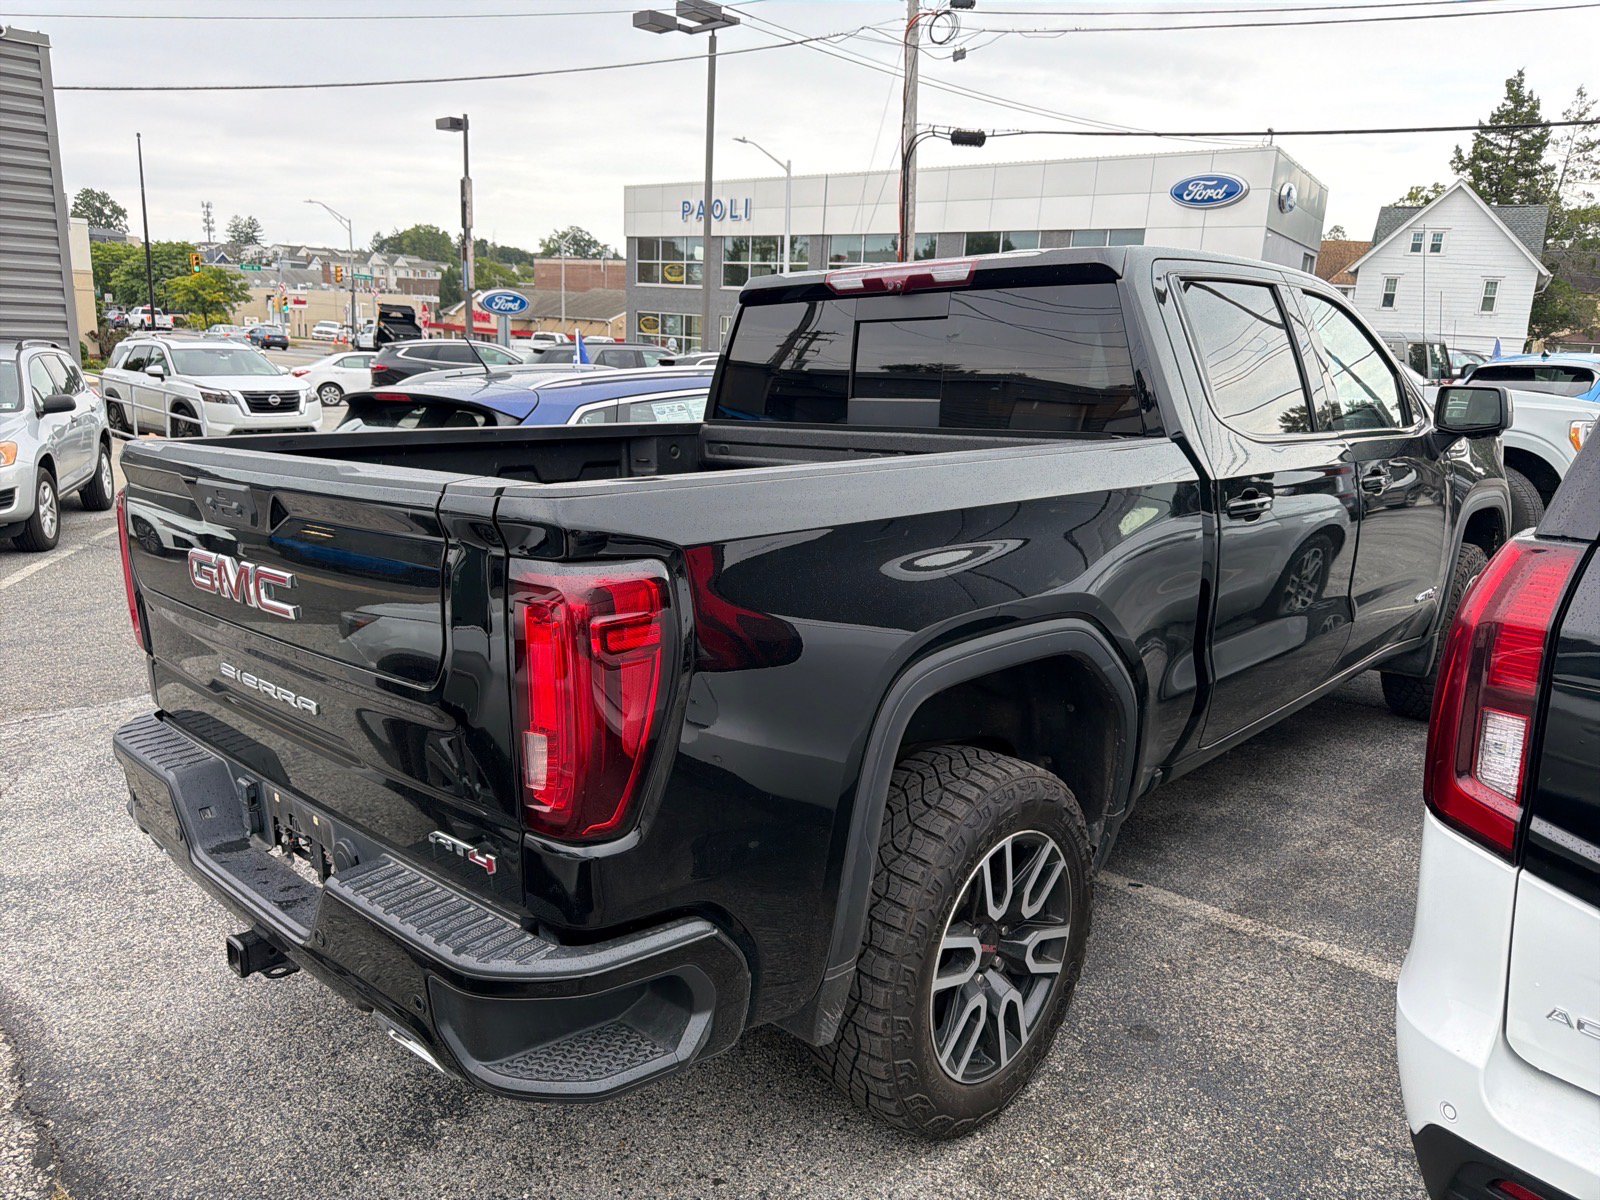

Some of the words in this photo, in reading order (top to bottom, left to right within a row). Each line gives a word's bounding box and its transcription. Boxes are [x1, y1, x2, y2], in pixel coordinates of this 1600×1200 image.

[1183, 180, 1229, 201] Ford
[681, 198, 751, 221] PAOLI
[492, 295, 521, 311] Ford
[188, 547, 302, 621] GMC
[220, 661, 321, 716] SIERRA
[428, 830, 497, 876] AT4
